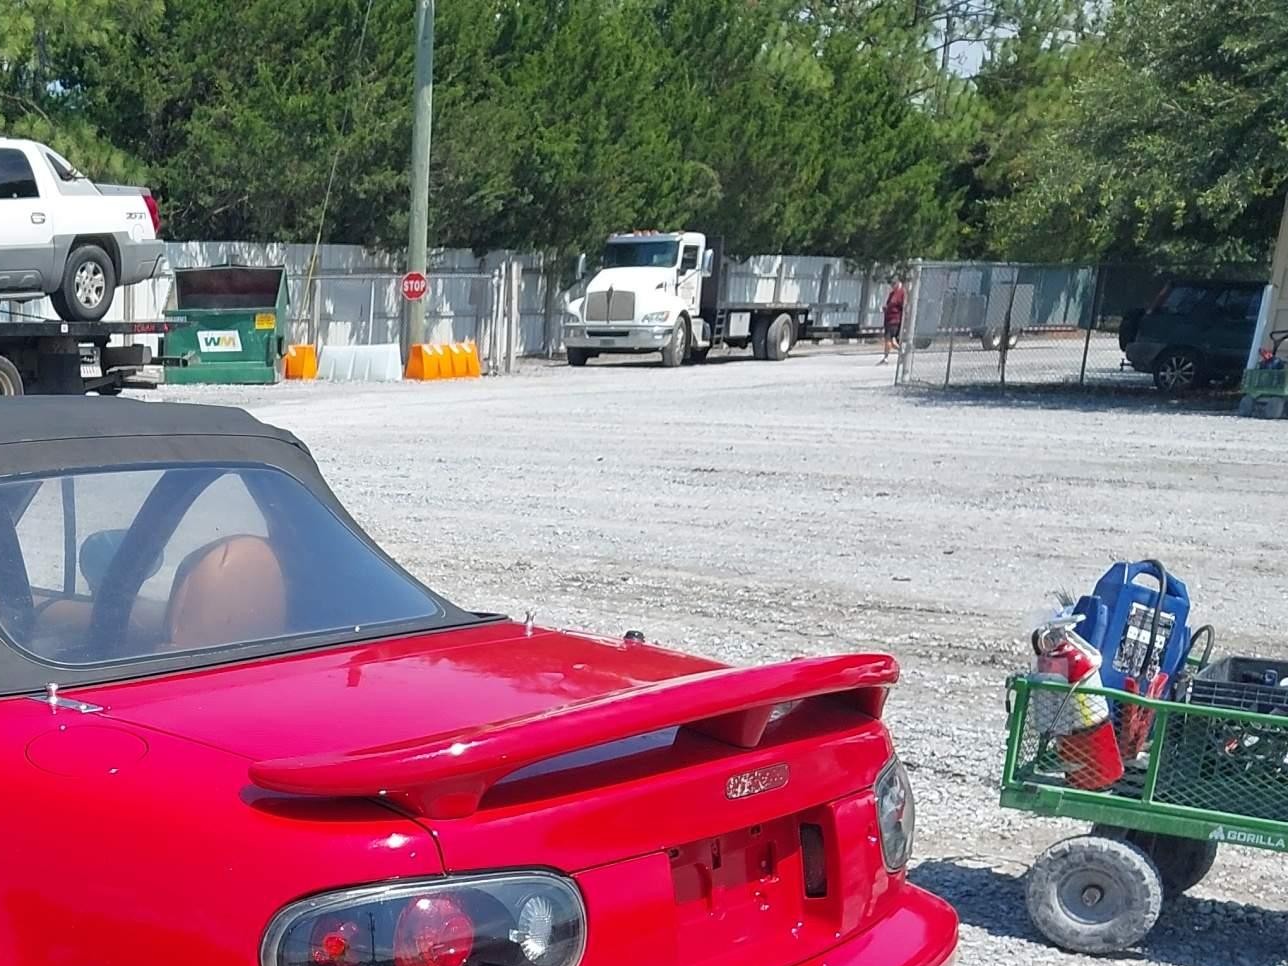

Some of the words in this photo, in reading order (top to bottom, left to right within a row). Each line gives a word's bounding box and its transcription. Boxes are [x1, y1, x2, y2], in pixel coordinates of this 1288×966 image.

[403, 279, 426, 292] STOP
[204, 335, 236, 347] WM
[1226, 830, 1286, 849] GORILLA
